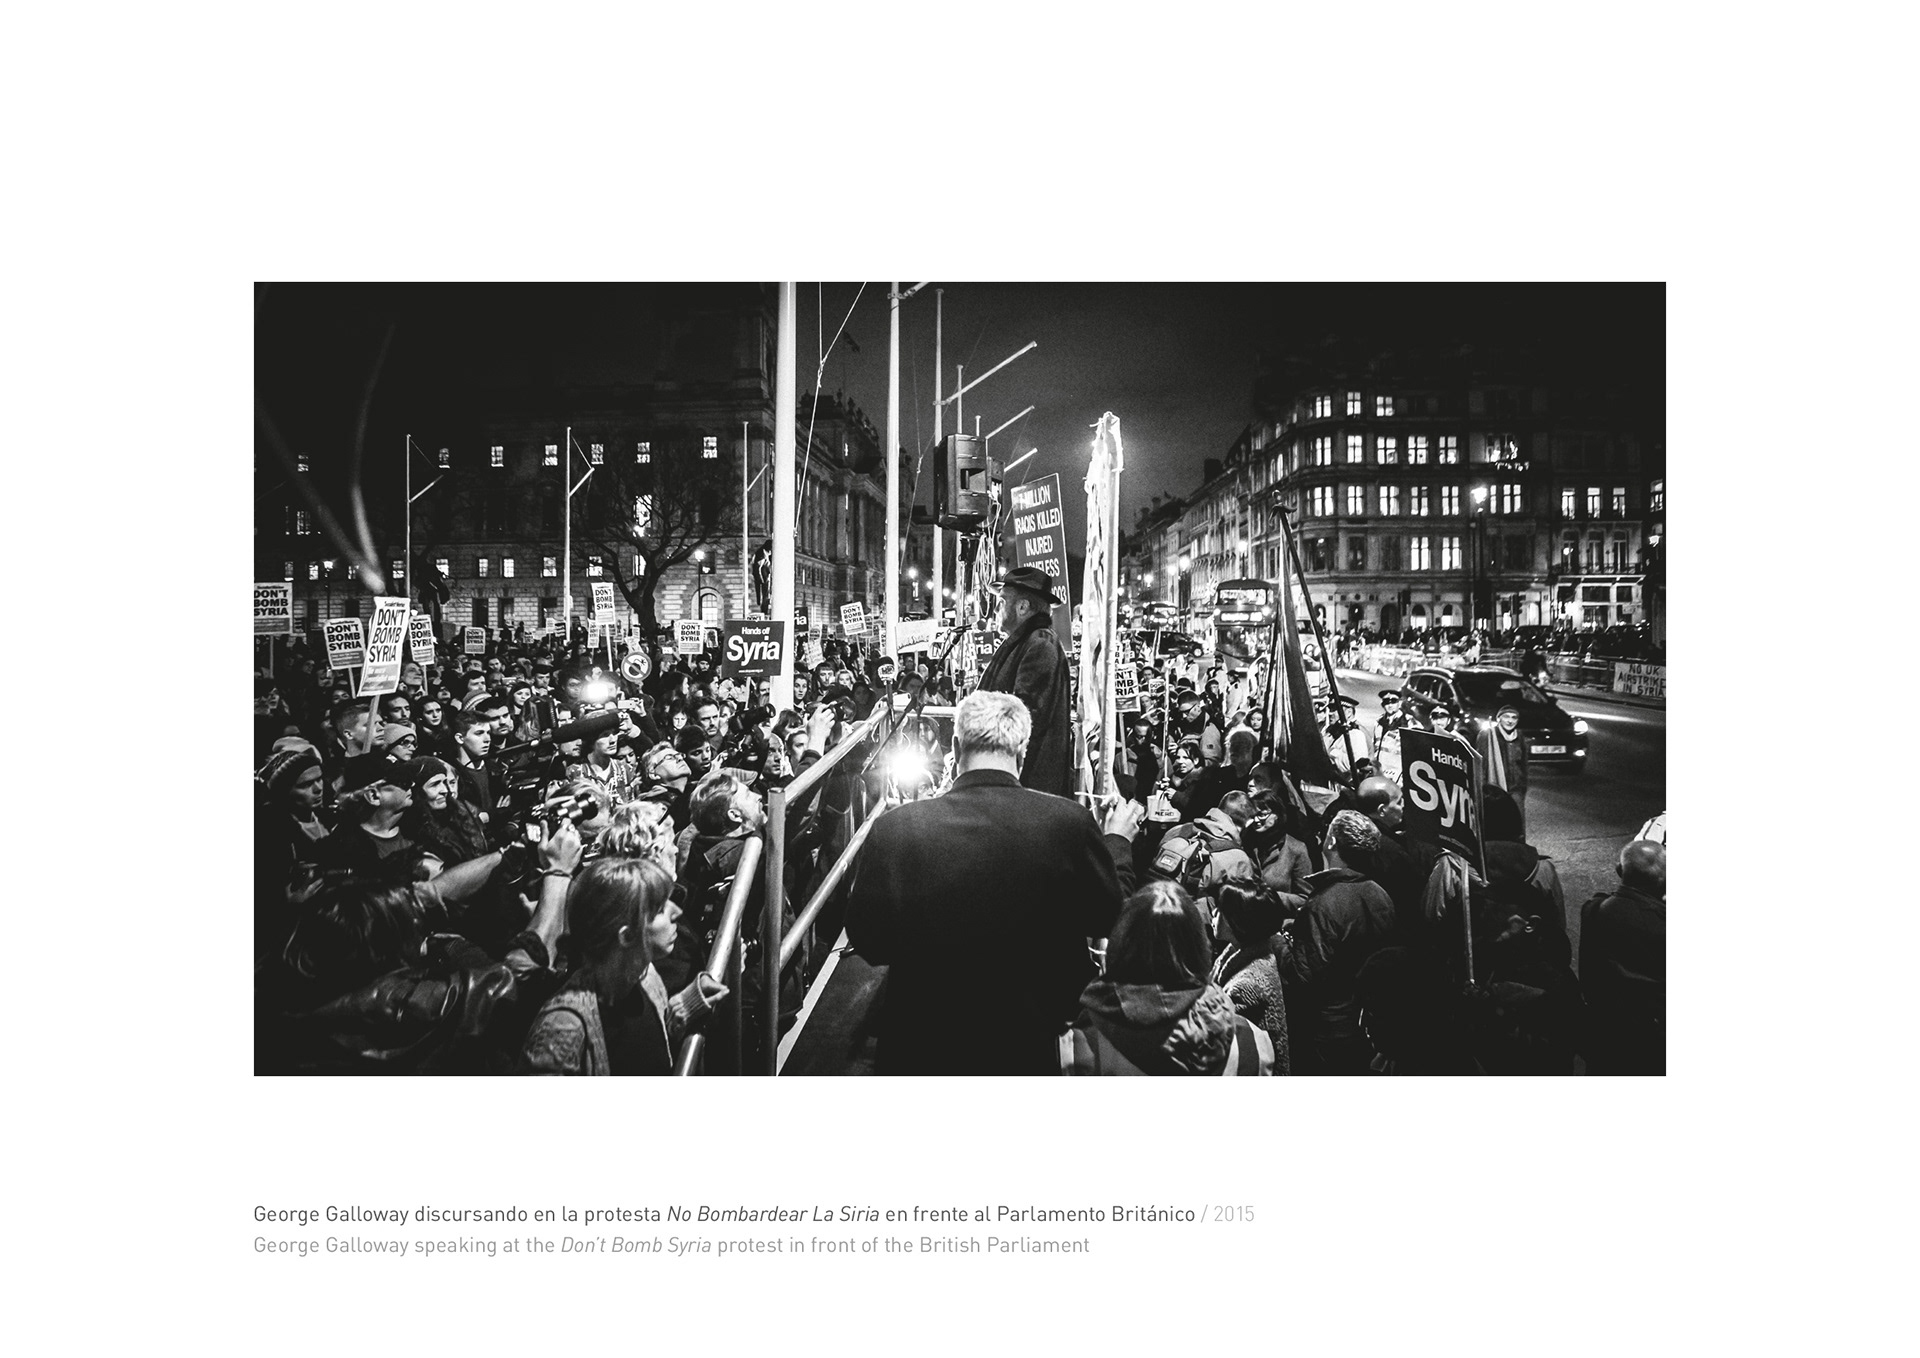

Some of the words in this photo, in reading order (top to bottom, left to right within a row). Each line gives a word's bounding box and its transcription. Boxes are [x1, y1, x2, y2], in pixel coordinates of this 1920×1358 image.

[1036, 507, 1060, 530] KILLED
[1025, 534, 1053, 556] INJURED
[254, 590, 288, 598] DON'T
[254, 599, 288, 607] BOMB
[254, 608, 288, 616] SYRIA
[377, 609, 406, 626] DON'T
[327, 624, 359, 634] DON'T
[411, 621, 430, 630] DON'T
[328, 632, 361, 642] BOMB
[372, 627, 402, 644] BOMB
[411, 630, 432, 639] BOMB
[329, 641, 362, 651] SYRIA
[412, 639, 432, 648] SYRIA
[368, 645, 397, 663] SYRIA
[726, 635, 780, 666] Syria
[1629, 664, 1641, 674] NO
[1646, 665, 1660, 675] UK
[1624, 683, 1632, 693] IN
[1638, 685, 1665, 697] SYRIA
[1431, 747, 1463, 770] Hands
